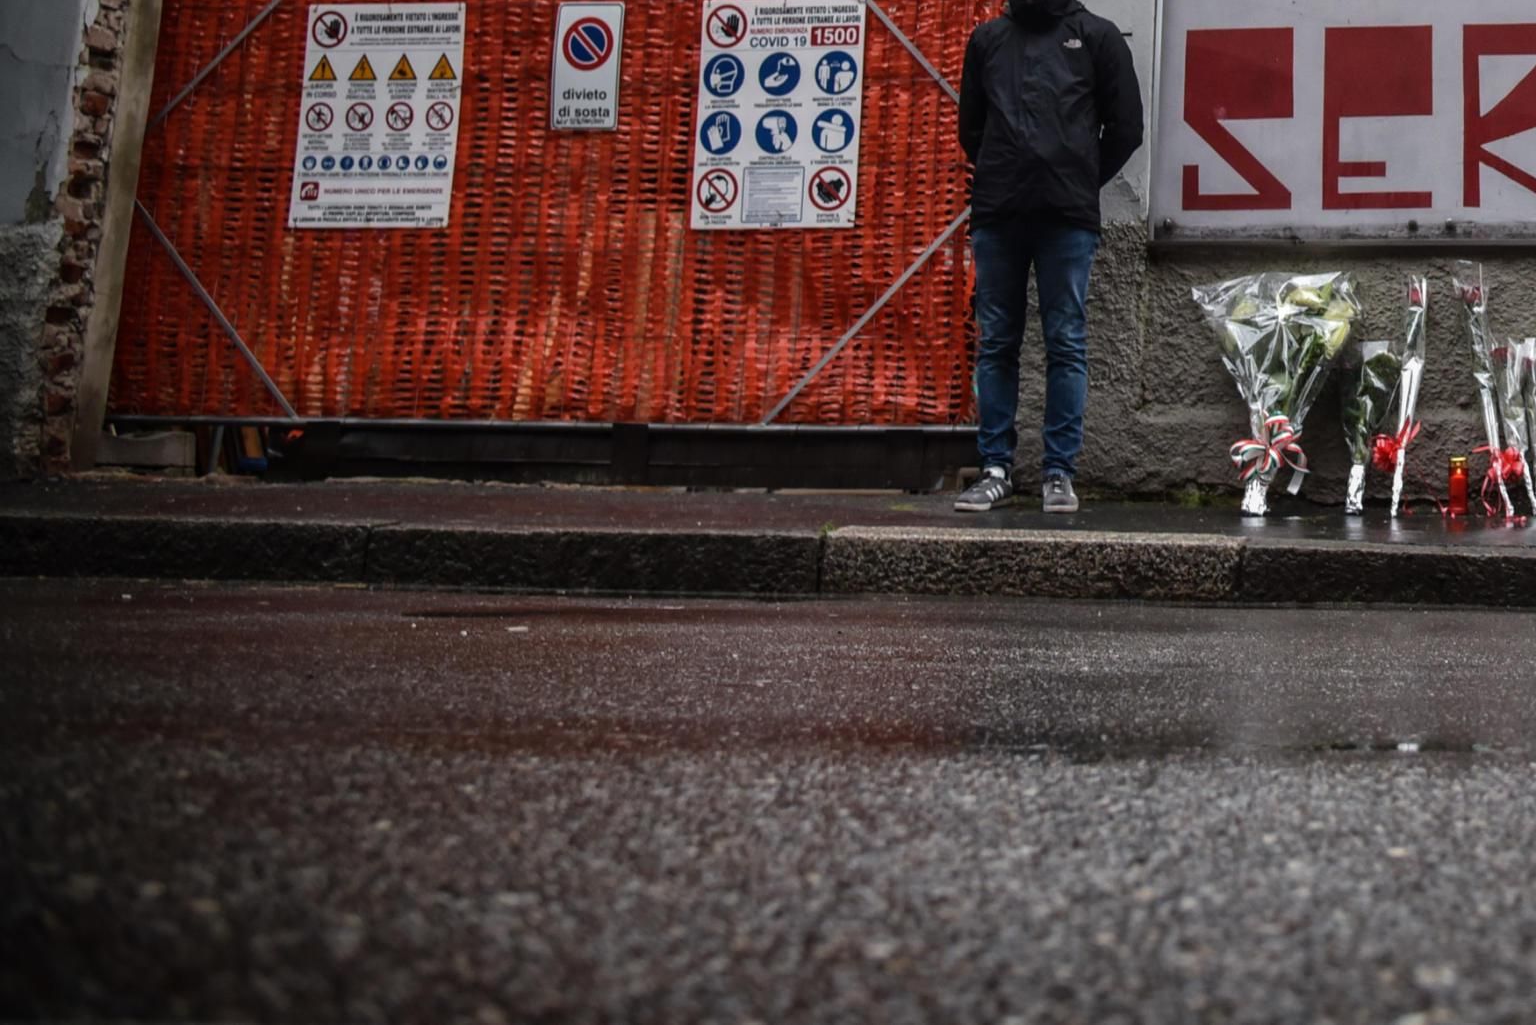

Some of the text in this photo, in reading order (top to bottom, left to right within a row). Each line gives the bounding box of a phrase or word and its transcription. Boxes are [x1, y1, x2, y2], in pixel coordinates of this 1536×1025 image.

[805, 6, 827, 15] VIETATO
[756, 17, 773, 25] TUTTE
[782, 16, 805, 25] PERSONE
[807, 16, 834, 24] ESTRANEE
[842, 15, 861, 23] LAVORI
[750, 35, 807, 48] COVID 19
[814, 28, 857, 45] 1500
[562, 87, 607, 100] divieto
[558, 105, 610, 117] di sosta
